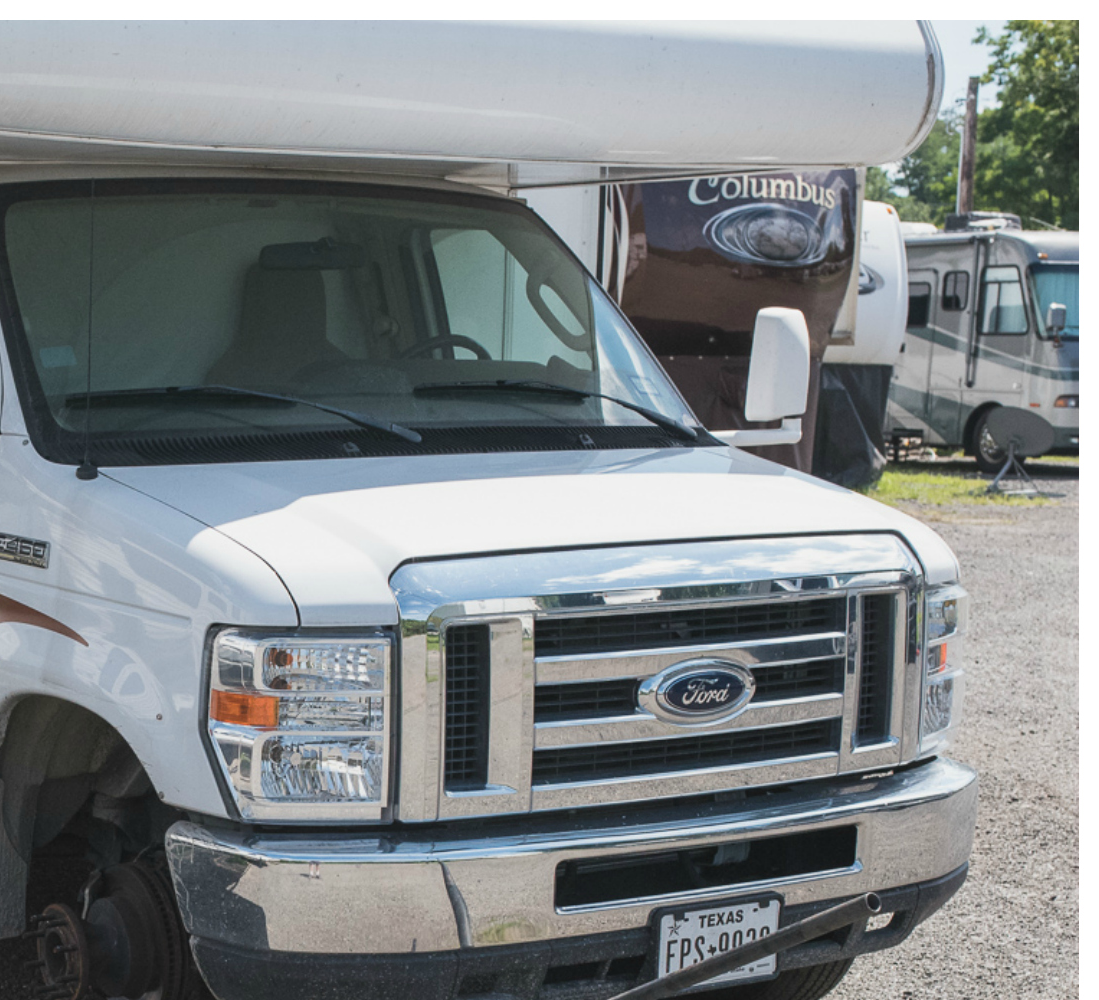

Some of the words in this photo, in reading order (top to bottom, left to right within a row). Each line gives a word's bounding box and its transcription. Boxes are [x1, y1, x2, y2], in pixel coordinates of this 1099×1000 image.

[688, 175, 835, 209] Columbus
[682, 678, 731, 705] Ford
[699, 909, 744, 929] TEXAS
